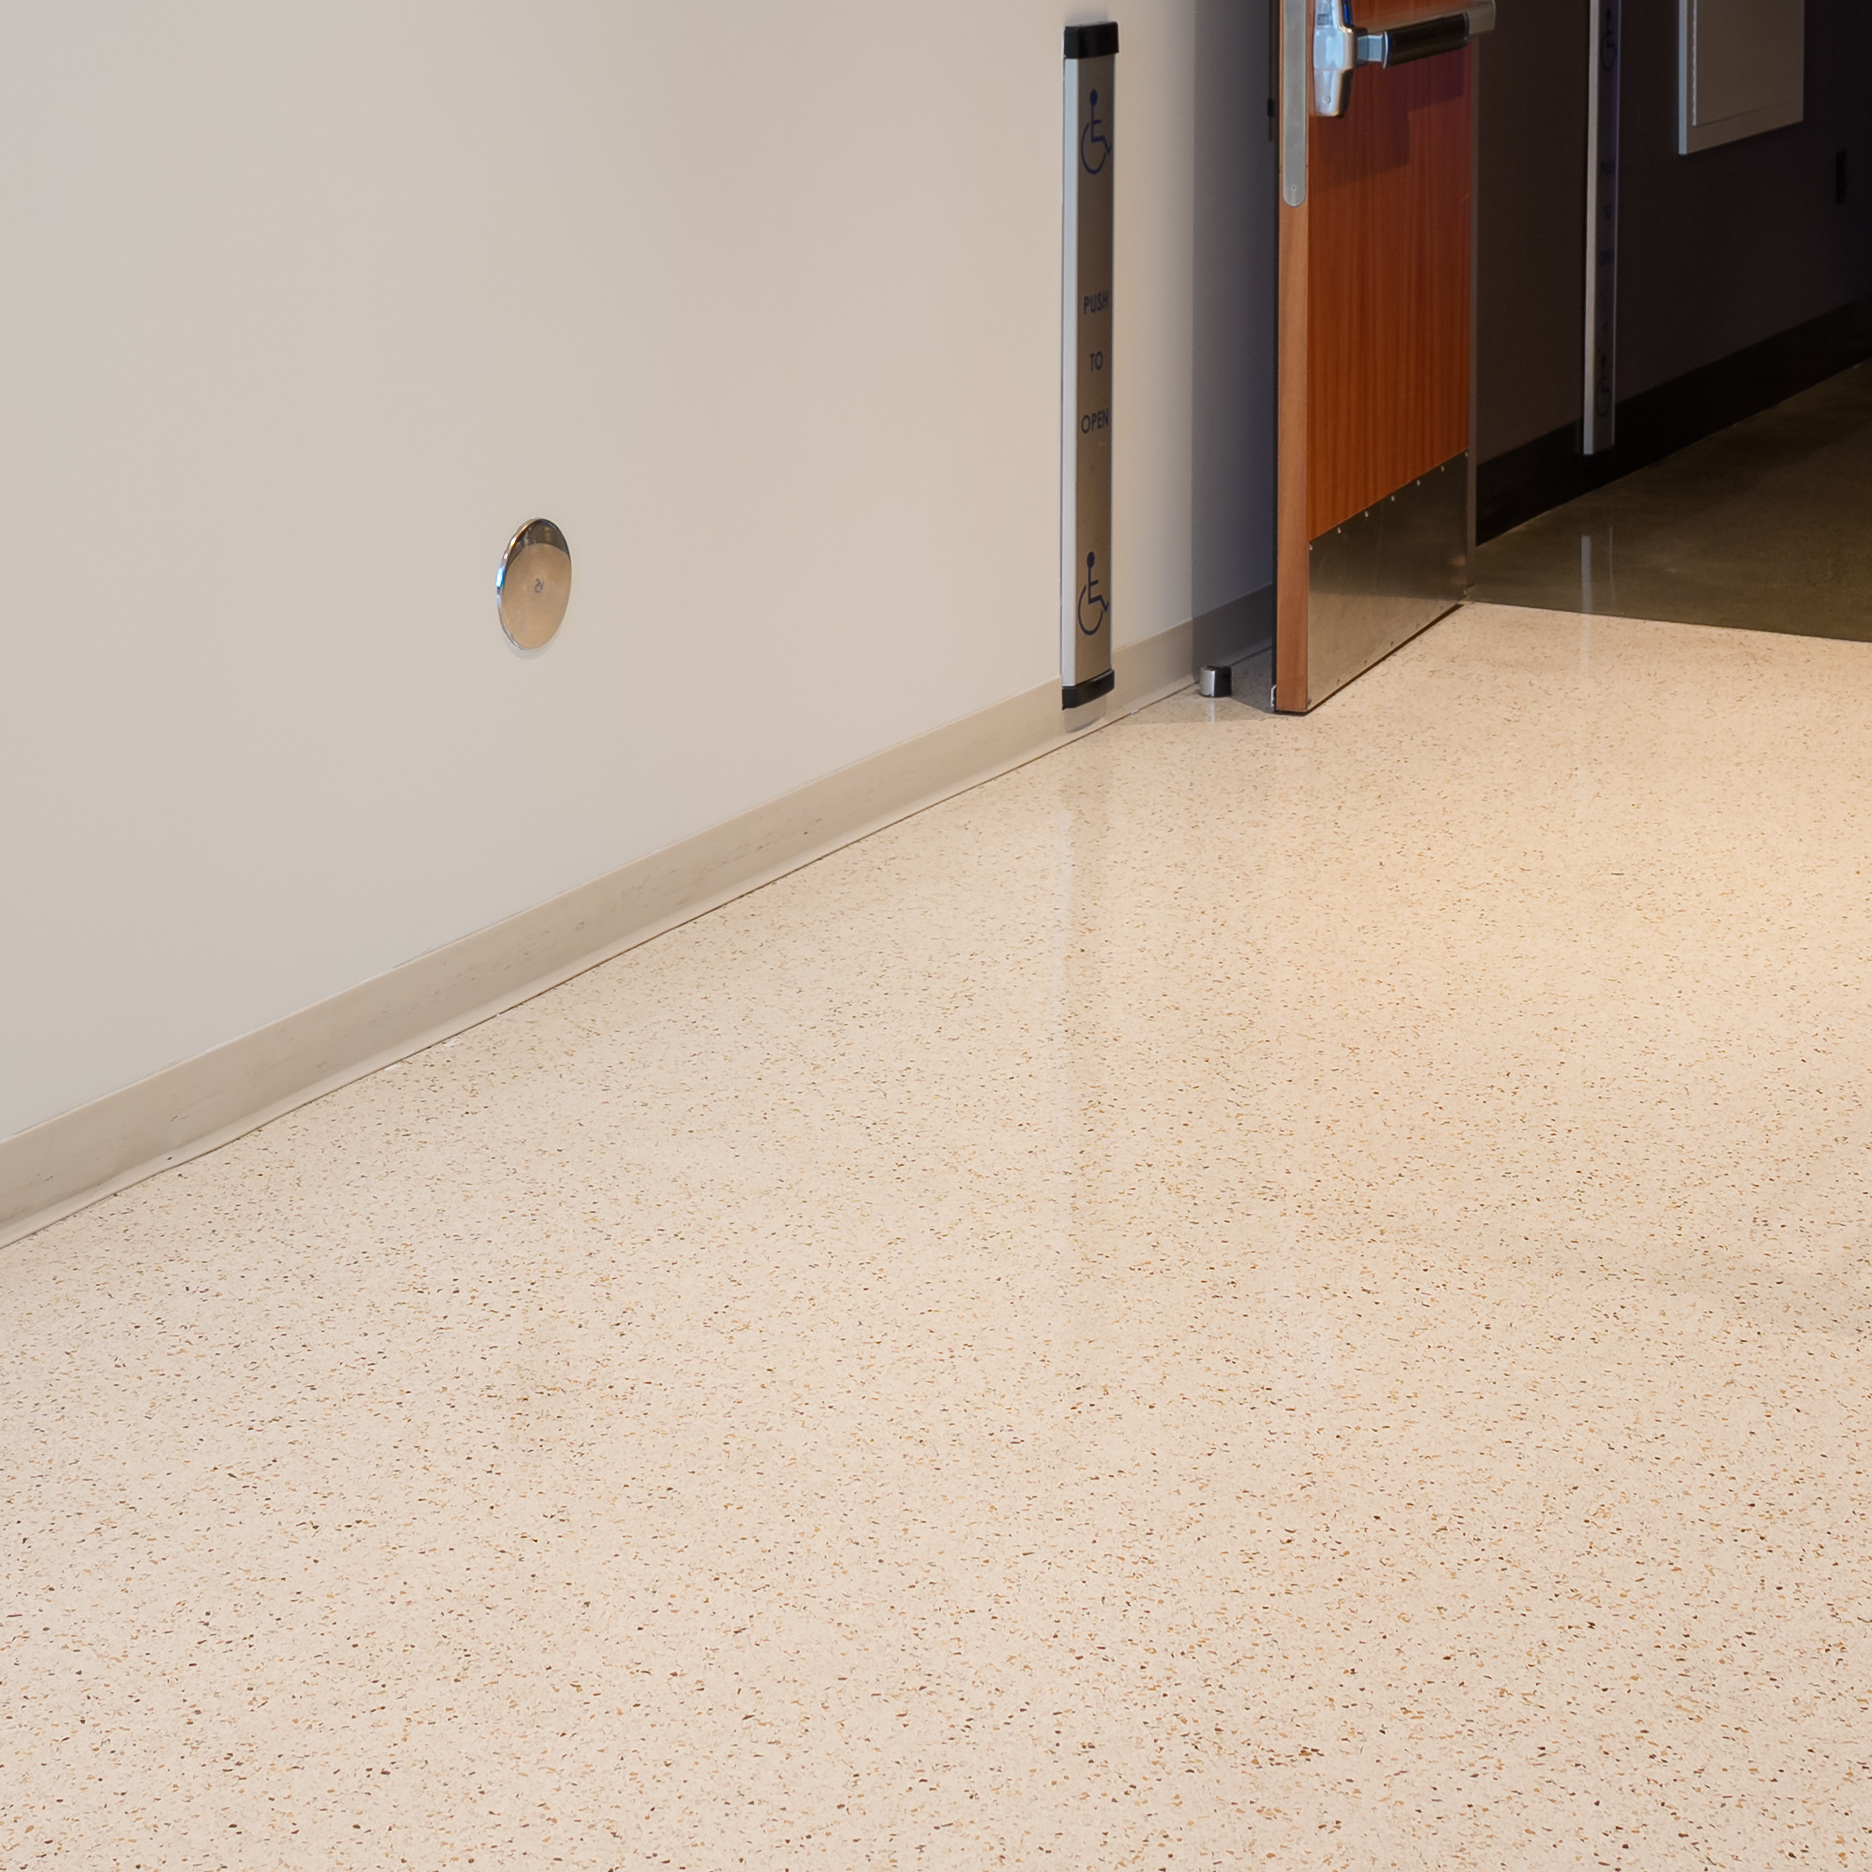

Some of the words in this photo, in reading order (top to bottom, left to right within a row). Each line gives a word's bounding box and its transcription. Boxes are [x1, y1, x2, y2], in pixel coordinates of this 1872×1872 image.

[1083, 291, 1110, 315] PUSH
[1090, 351, 1104, 372] TO
[1081, 408, 1110, 434] OPEN
